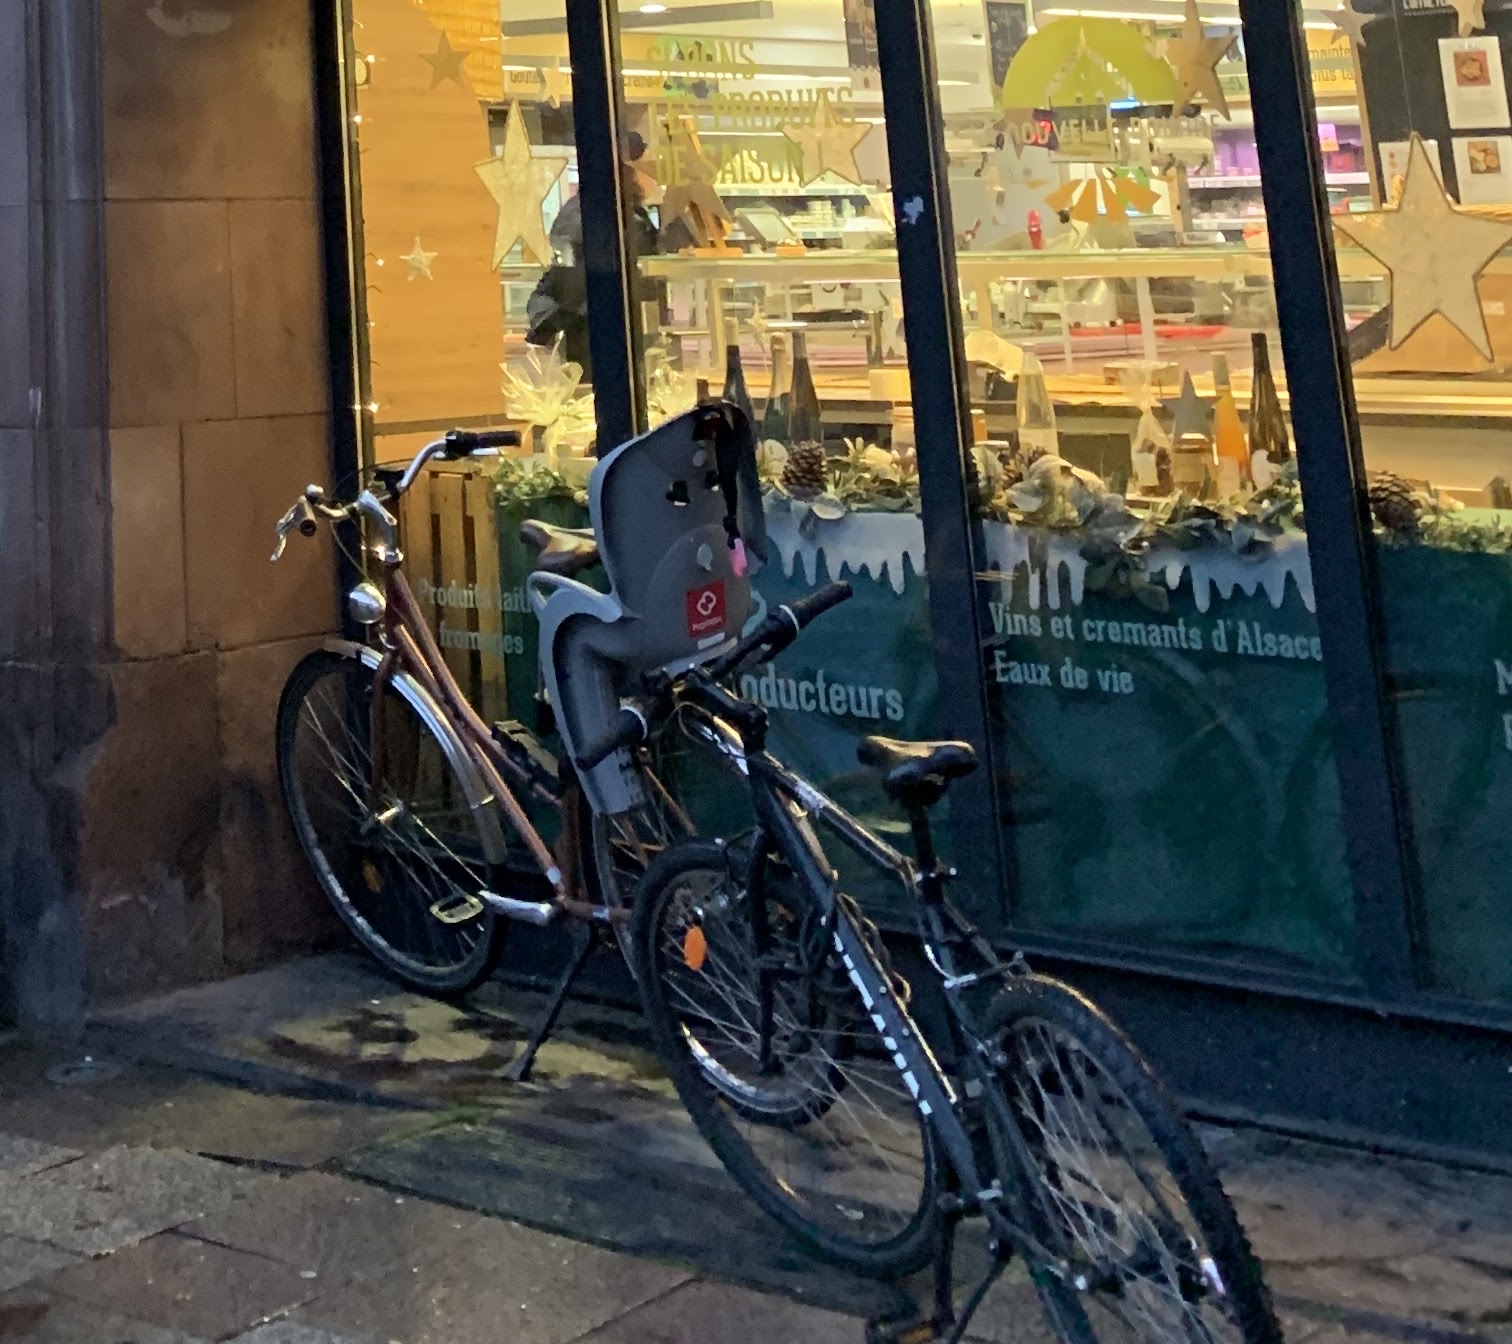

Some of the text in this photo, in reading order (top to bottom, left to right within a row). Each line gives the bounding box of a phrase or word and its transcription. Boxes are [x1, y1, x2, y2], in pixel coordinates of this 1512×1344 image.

[989, 601, 1042, 638] Vins
[1050, 614, 1075, 641] et
[993, 650, 1135, 694] Eaux de vie
